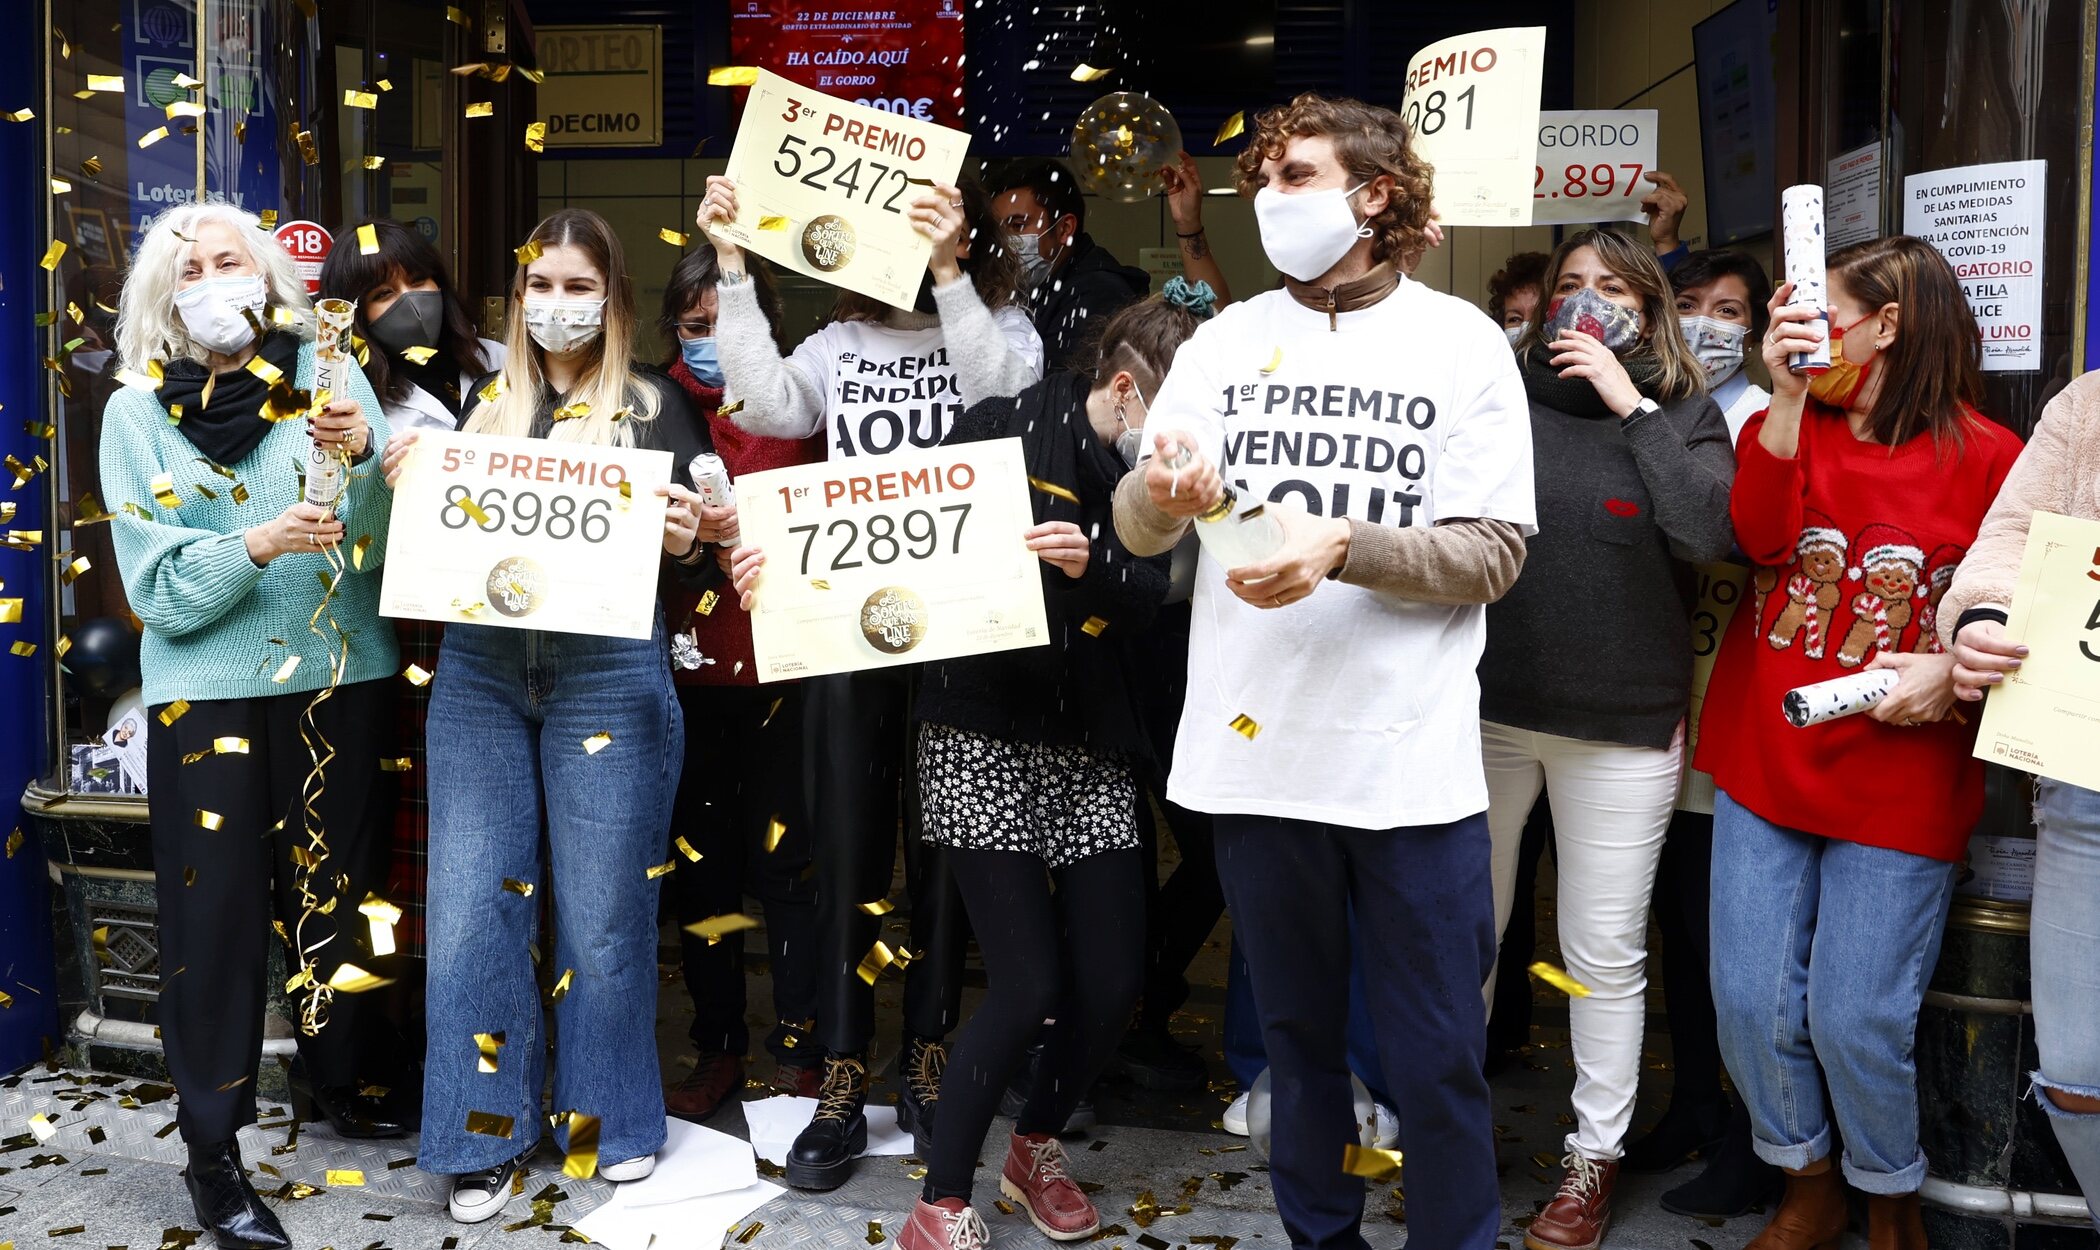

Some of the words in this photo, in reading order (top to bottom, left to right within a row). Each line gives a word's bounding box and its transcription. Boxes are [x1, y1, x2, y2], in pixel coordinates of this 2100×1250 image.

[797, 12, 809, 21] 22
[813, 12, 828, 21] DE
[832, 11, 896, 21] DICIEMBRE
[786, 52, 810, 66] HA
[813, 49, 865, 66] CAÍDO
[866, 48, 910, 67] AQUÍ
[819, 76, 834, 86] EL
[835, 76, 876, 86] GORDO
[1401, 84, 1475, 136] 981
[548, 112, 641, 135] DECIMO
[781, 98, 817, 123] 3er
[823, 113, 926, 161] PREMIO
[1539, 124, 1639, 147] GORDO
[773, 133, 910, 214] 52472
[137, 182, 225, 204] Loteras
[1916, 189, 1928, 200] EN
[1930, 178, 2026, 197] CUMPLIMIENTO
[1924, 204, 1935, 214] DE
[1938, 201, 1956, 212] LAS
[1958, 196, 2013, 209] MEDIDAS
[1934, 213, 1997, 228] SANITARIAS
[282, 229, 322, 254] +18
[1937, 233, 1948, 243] LA
[1951, 225, 2029, 241] CONTENCIÓN
[1948, 243, 2006, 258] COVID-19
[1976, 284, 2009, 298] FILA
[1991, 325, 2031, 339] UNO
[837, 373, 962, 404] ENDID
[1264, 384, 1436, 431] PREMIO
[1225, 430, 1426, 481] VENDIDO
[487, 452, 627, 489] PREMIO
[778, 486, 810, 513] 1er
[824, 463, 975, 507] PREMIO
[440, 484, 612, 543] 86986
[788, 503, 972, 575] 72897
[2009, 753, 2045, 767] NACIONAL
[2010, 747, 2039, 760] LOTERÍA
